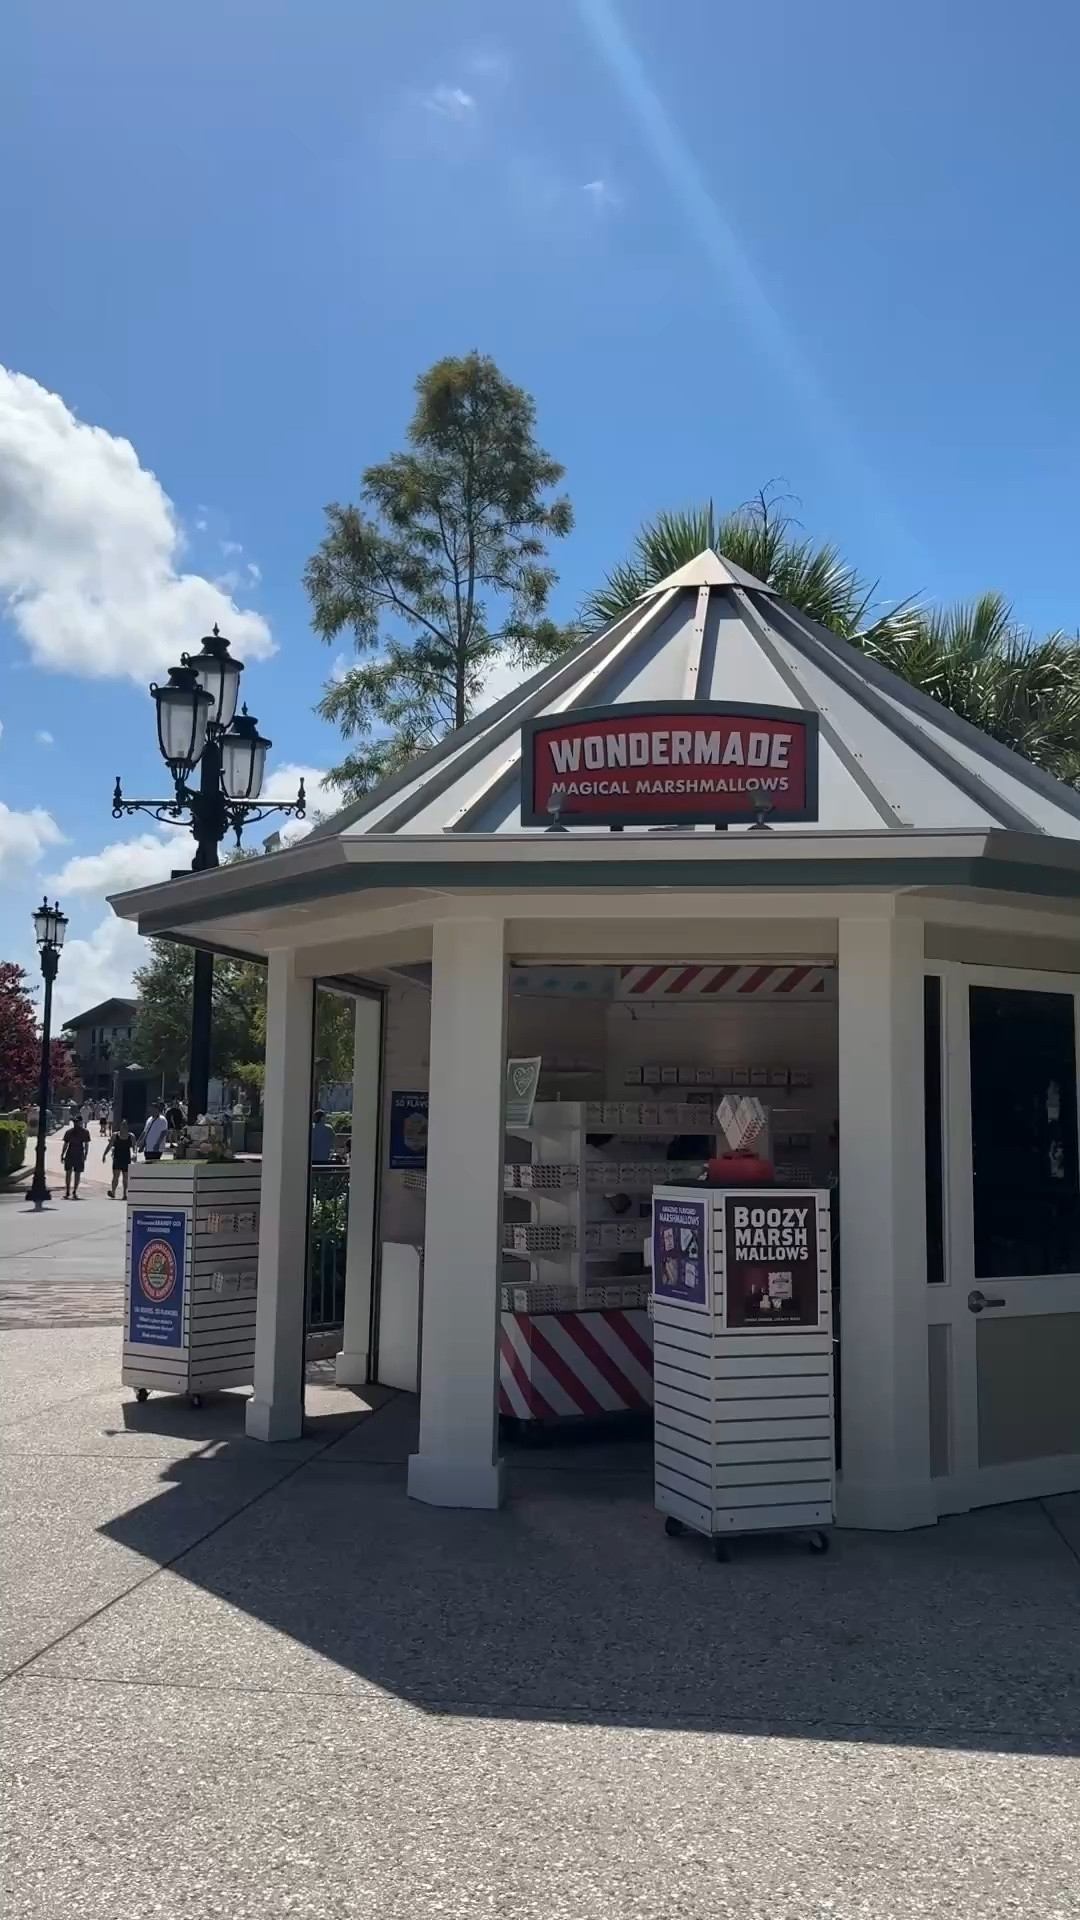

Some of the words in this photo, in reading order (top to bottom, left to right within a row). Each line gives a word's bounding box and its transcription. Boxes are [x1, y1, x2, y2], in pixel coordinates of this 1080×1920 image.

[549, 730, 793, 774] WONDERMADE
[551, 780, 630, 796] MAGICAL
[636, 777, 789, 794] MARSHMALLOWS
[659, 1213, 700, 1226] MARSHMALLOWS
[734, 1206, 808, 1228] BOOZY
[735, 1228, 808, 1246] MARSH
[735, 1247, 809, 1261] MALLOWS
